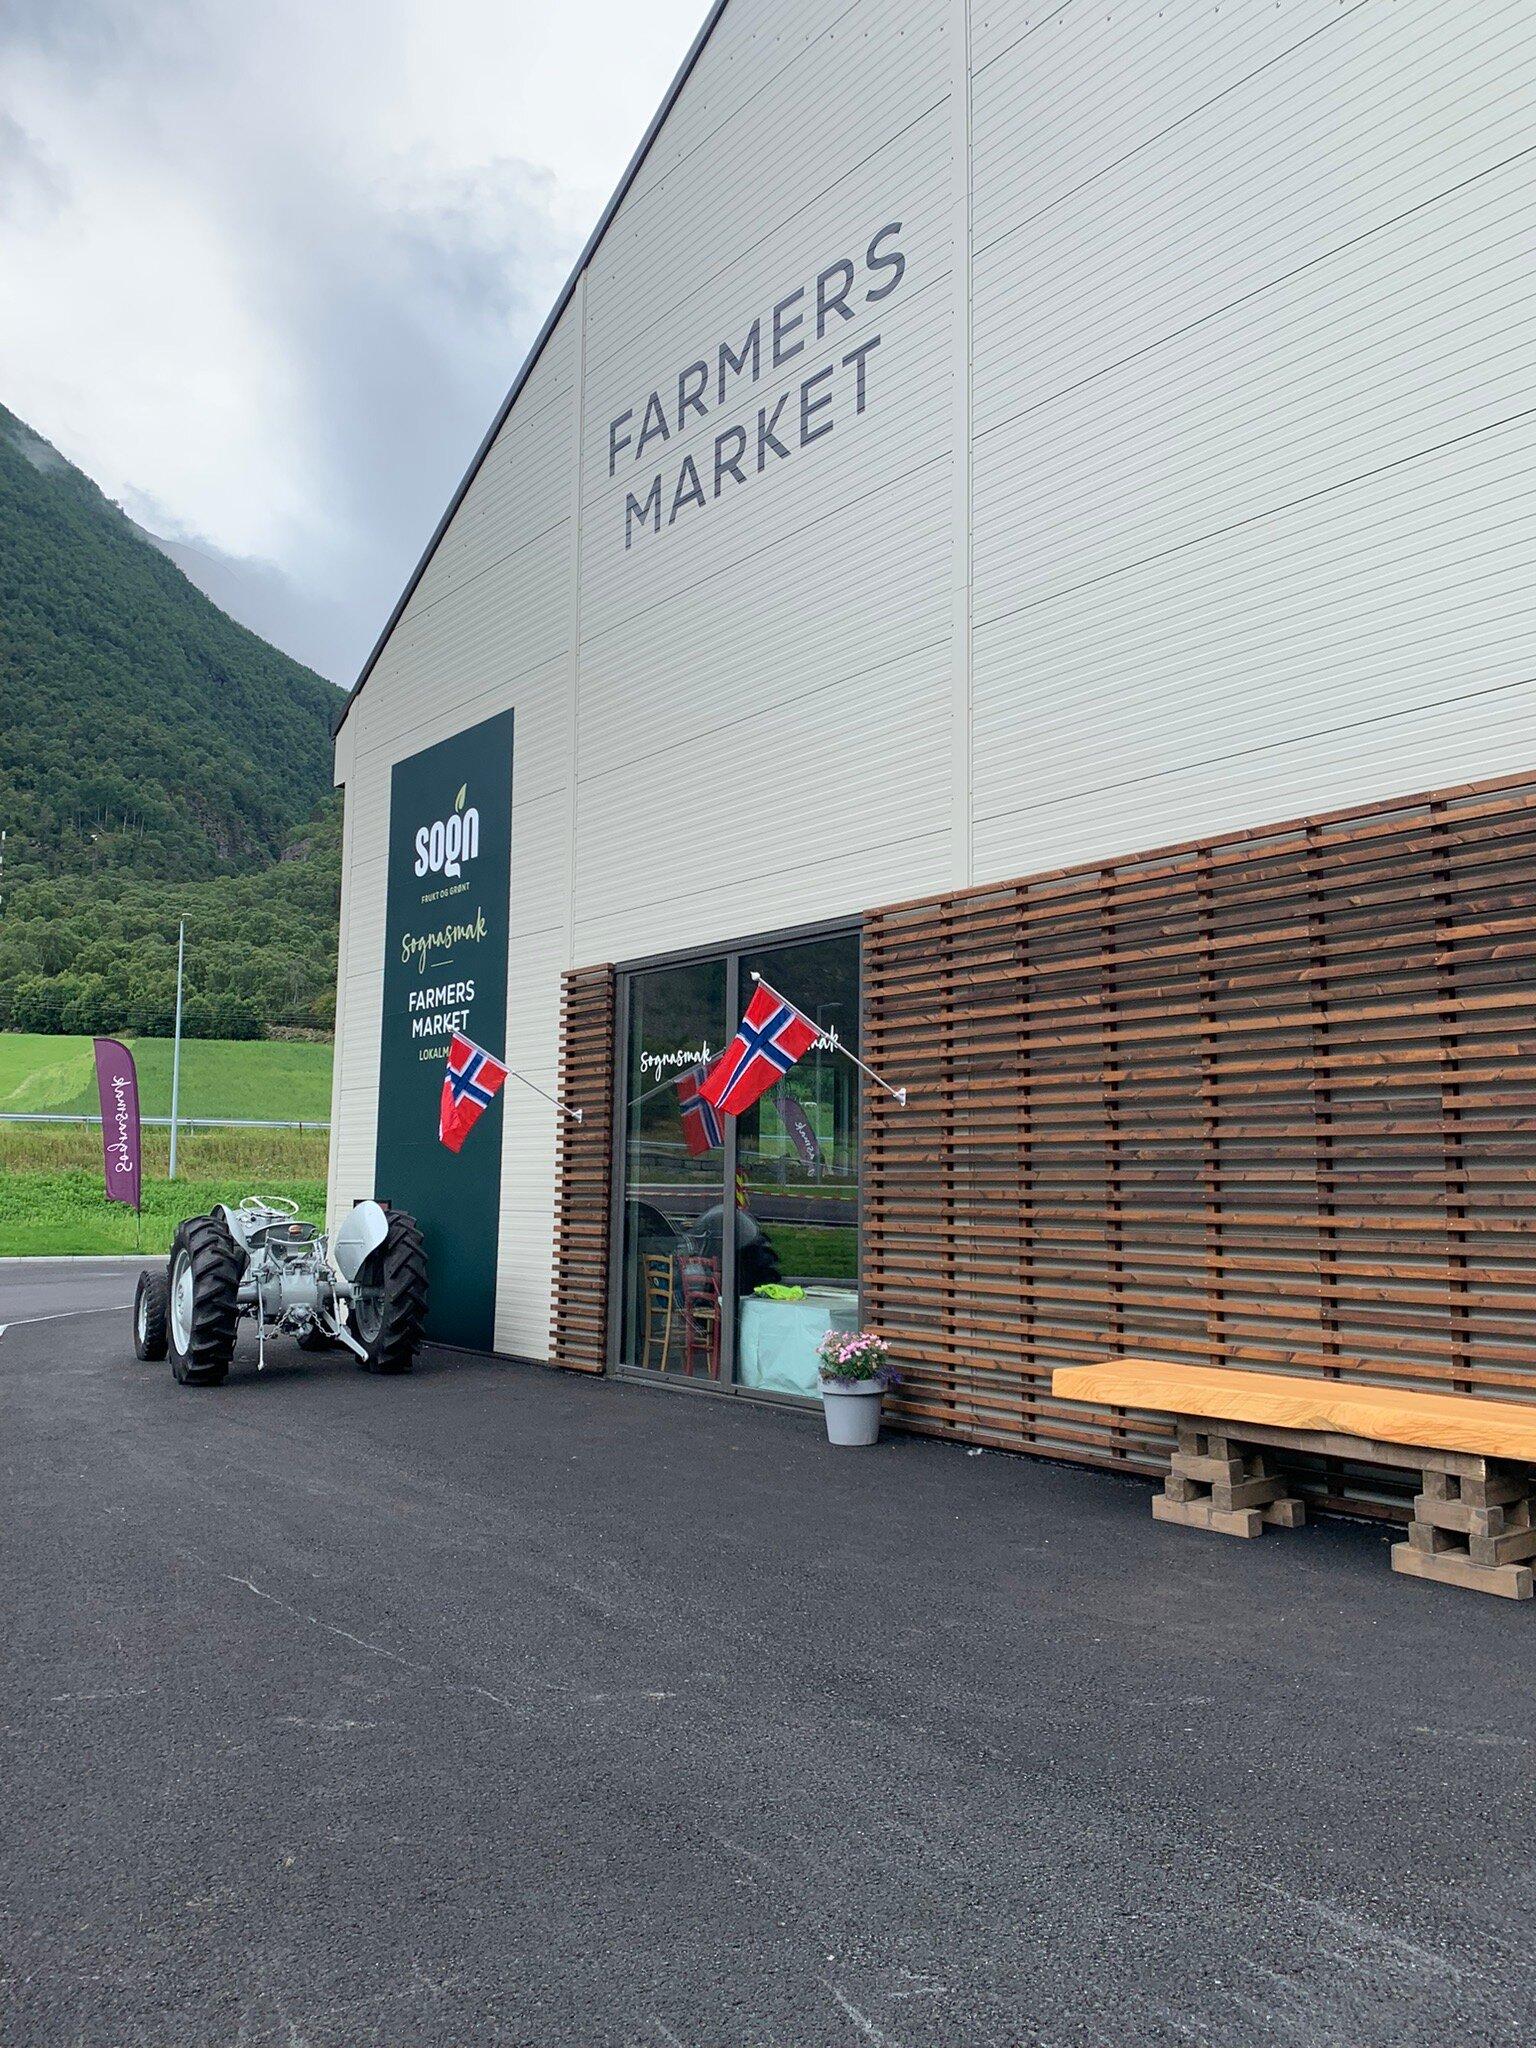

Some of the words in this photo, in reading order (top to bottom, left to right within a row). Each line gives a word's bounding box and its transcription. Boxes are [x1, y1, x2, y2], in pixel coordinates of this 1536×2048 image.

[609, 221, 906, 478] FARMERS
[625, 334, 881, 551] MARKET
[421, 891, 440, 904] FRUKT
[440, 888, 449, 899] OG
[401, 906, 488, 974] Sognasmak
[408, 979, 475, 1012] FARMERS
[412, 1009, 470, 1038] MARKET
[419, 1045, 452, 1062] LOKALM
